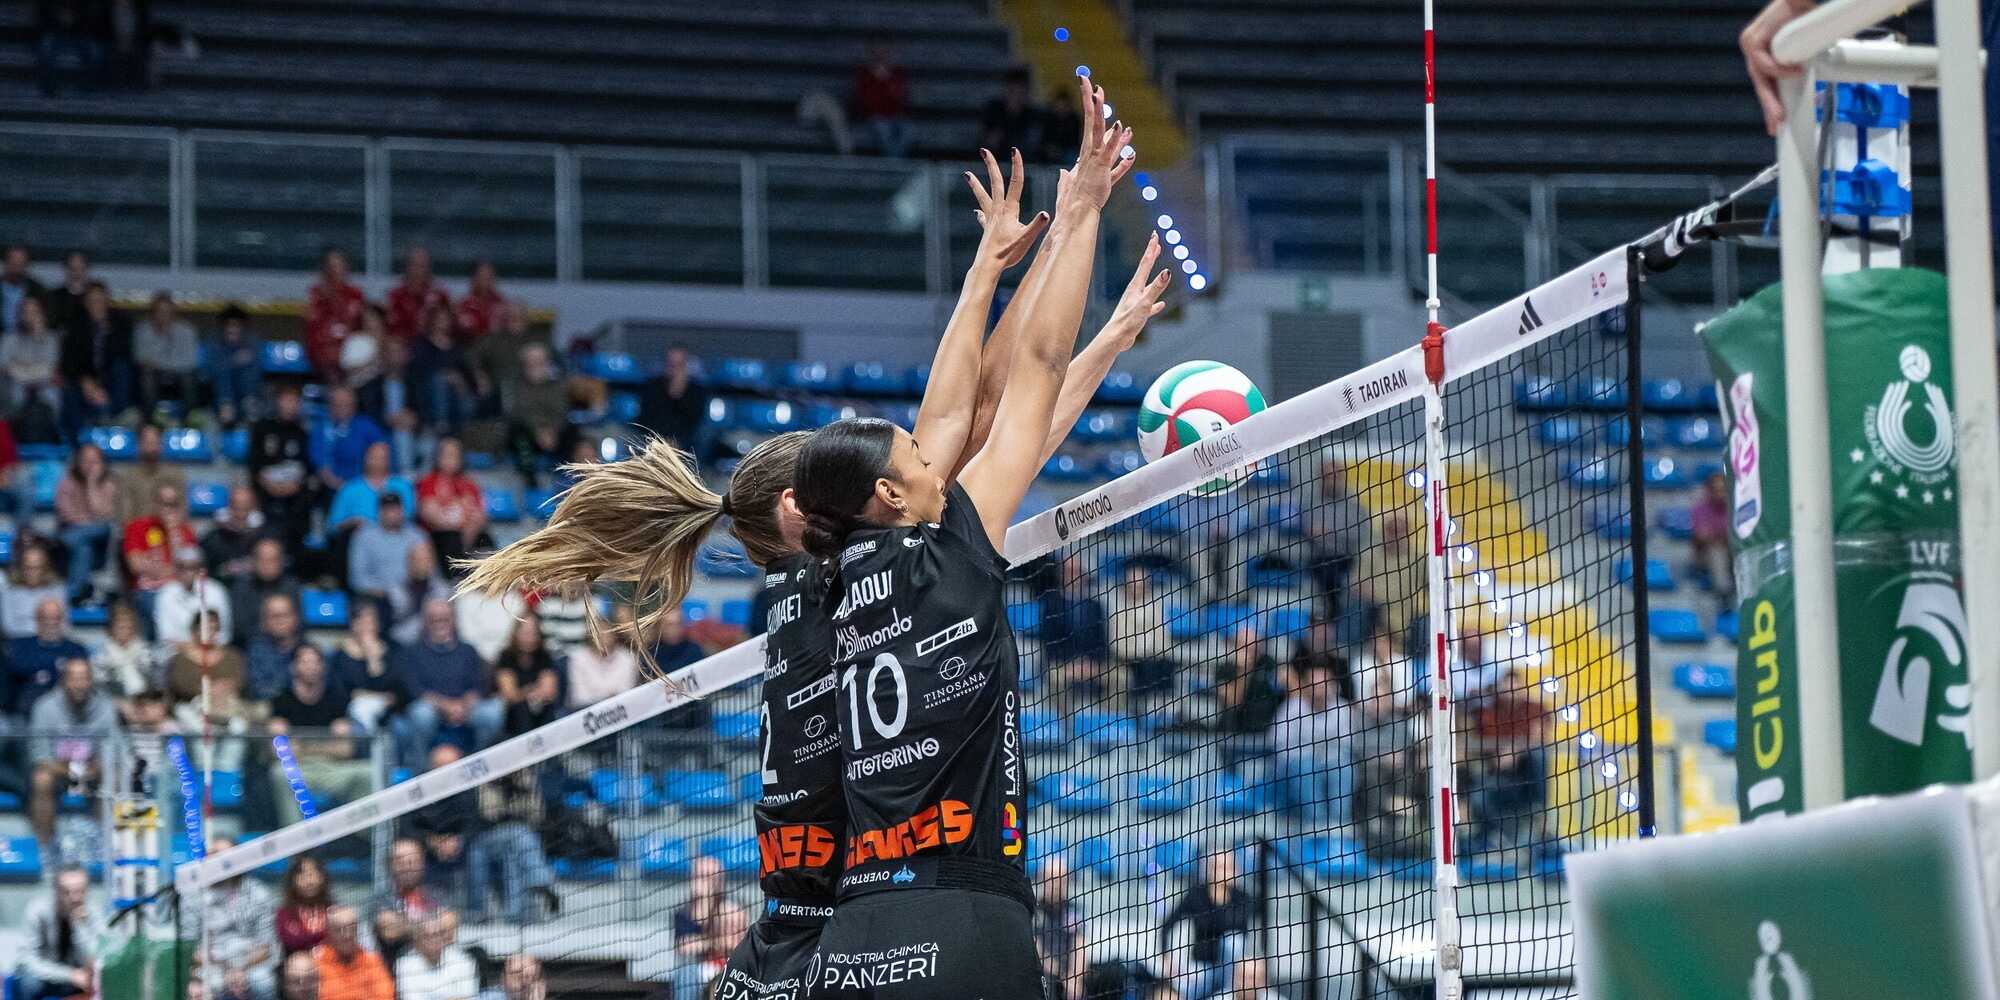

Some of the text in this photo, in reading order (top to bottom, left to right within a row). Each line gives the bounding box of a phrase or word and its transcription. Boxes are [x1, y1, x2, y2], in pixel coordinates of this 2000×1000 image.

[1359, 369, 1408, 402] TADIRAN
[1068, 493, 1113, 528] motorola
[923, 671, 986, 703] TINOSANA
[1748, 600, 1784, 770] Club
[842, 653, 908, 750] 10
[925, 696, 951, 709] MAKING
[793, 732, 841, 758] TINOSAN
[1004, 690, 1016, 796] LAVORO
[779, 904, 834, 917] OVERTRAQ
[827, 942, 940, 965] INDUSTRIA CHIMICA
